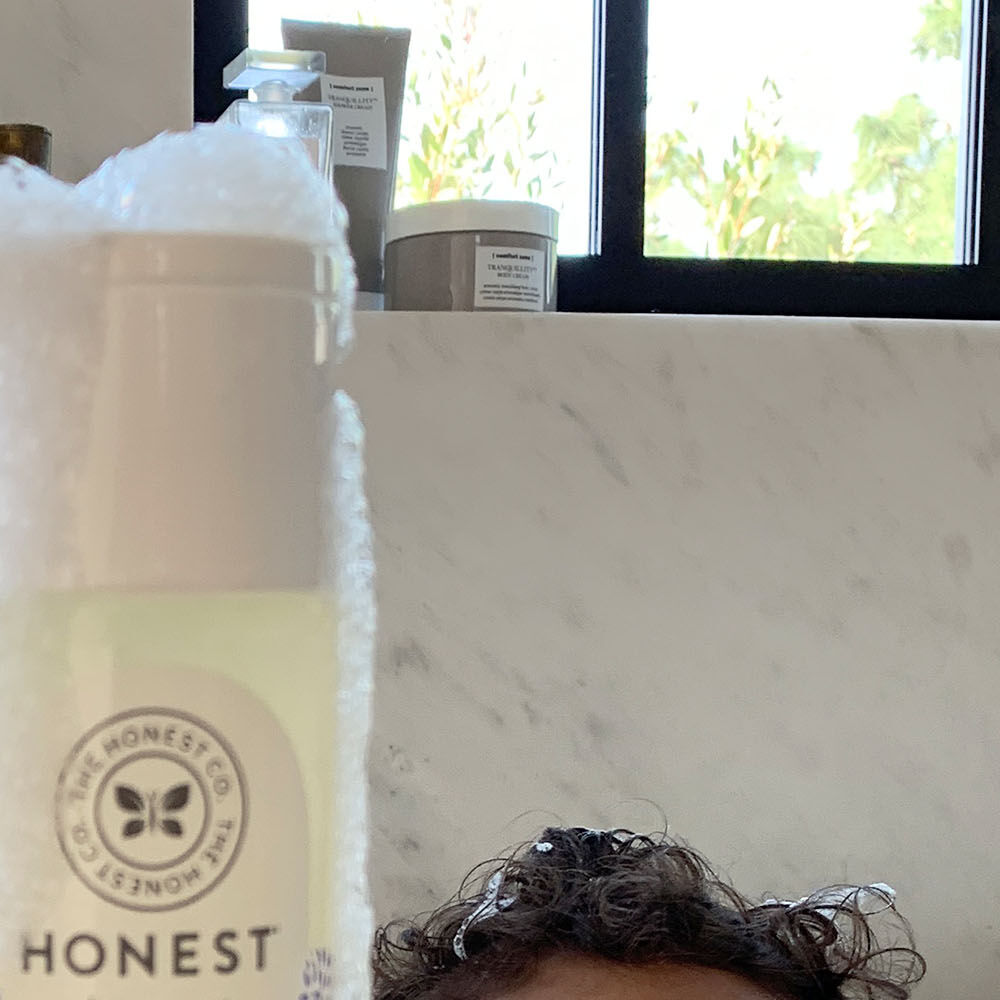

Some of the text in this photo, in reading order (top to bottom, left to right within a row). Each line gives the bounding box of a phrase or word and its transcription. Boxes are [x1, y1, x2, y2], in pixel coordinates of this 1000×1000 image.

[68, 751, 103, 800] THE
[103, 724, 208, 757] HONEST
[202, 819, 233, 865] THE
[97, 863, 200, 896] HONEST
[21, 926, 273, 977] HONEST
